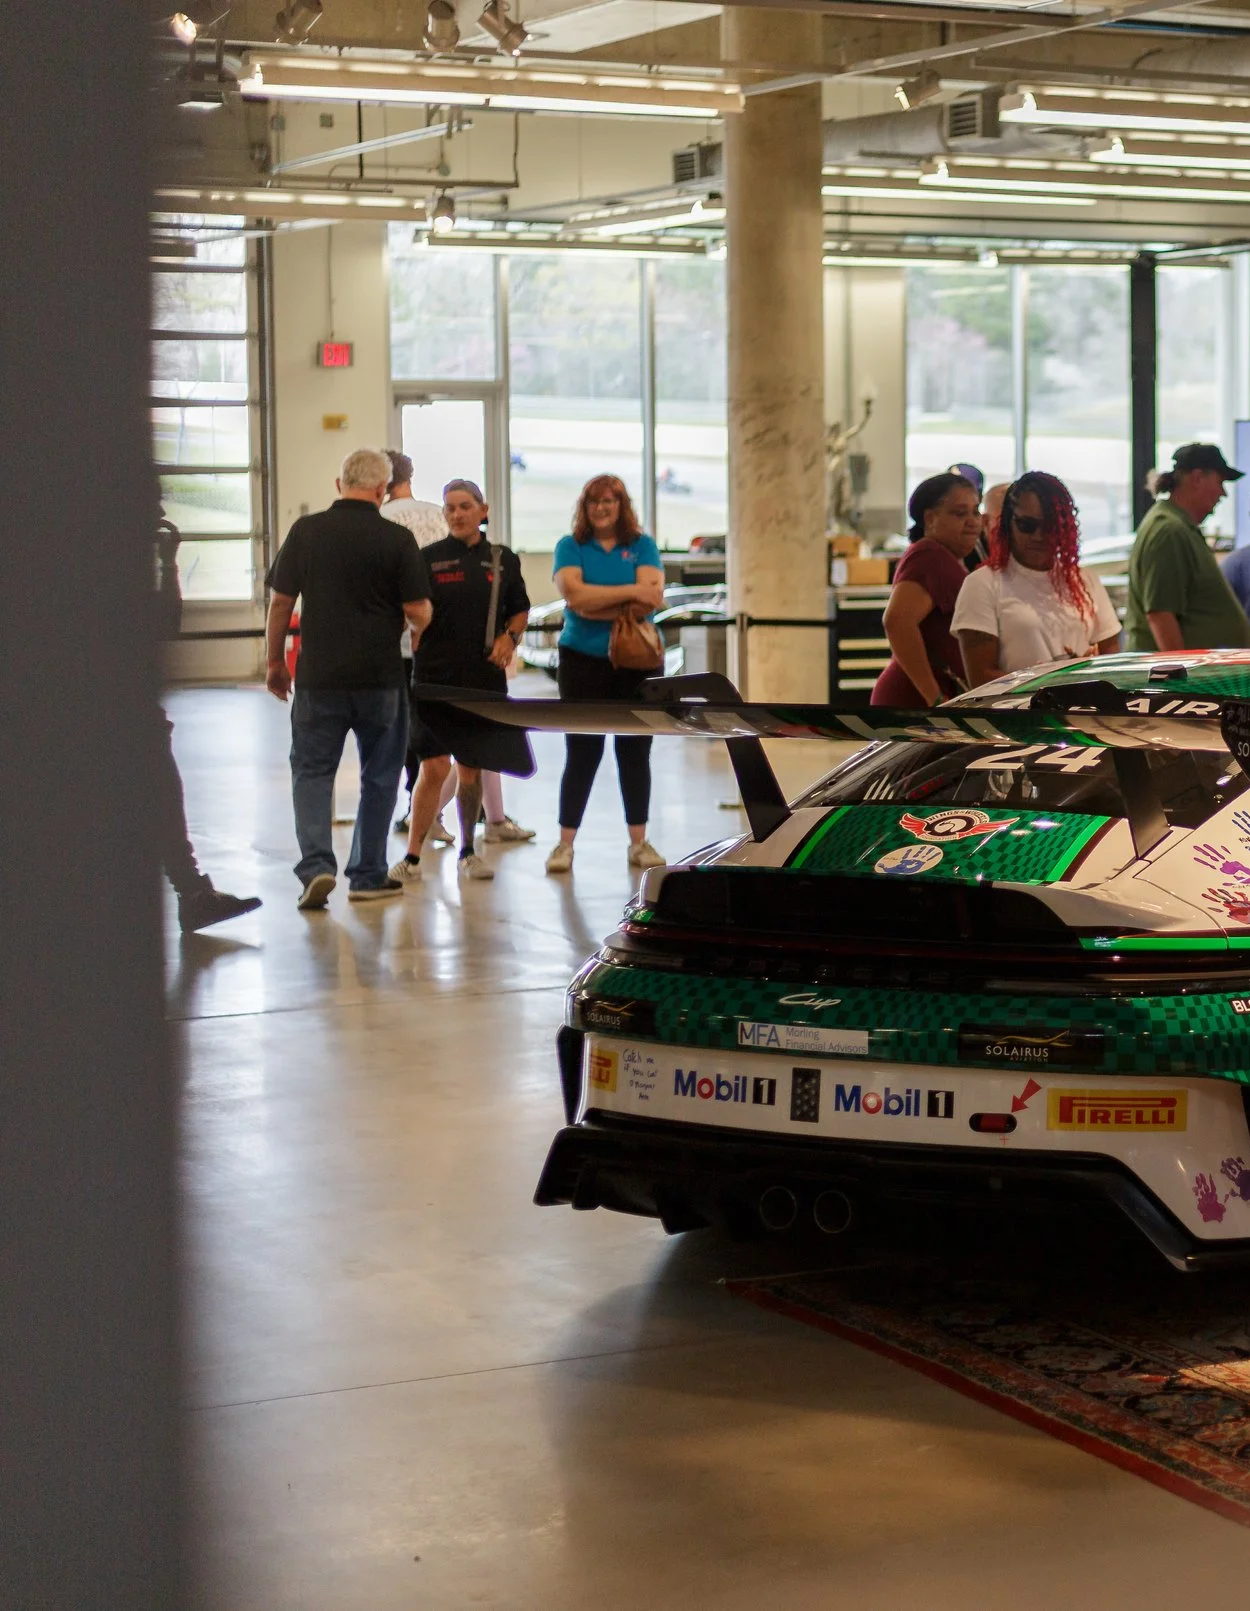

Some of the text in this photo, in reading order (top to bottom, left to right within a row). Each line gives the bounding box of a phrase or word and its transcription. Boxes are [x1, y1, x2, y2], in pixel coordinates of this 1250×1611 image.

[323, 343, 350, 367] EXIT
[779, 993, 841, 1010] Cup
[739, 1022, 781, 1048] MFA
[786, 1027, 820, 1041] Morling
[785, 1039, 867, 1054] Financial Advisors
[985, 1045, 1049, 1058] SOLAIRUS
[674, 1069, 747, 1103] Mobil
[834, 1084, 920, 1117] Mobil
[1059, 1096, 1177, 1125] PIRELLI
